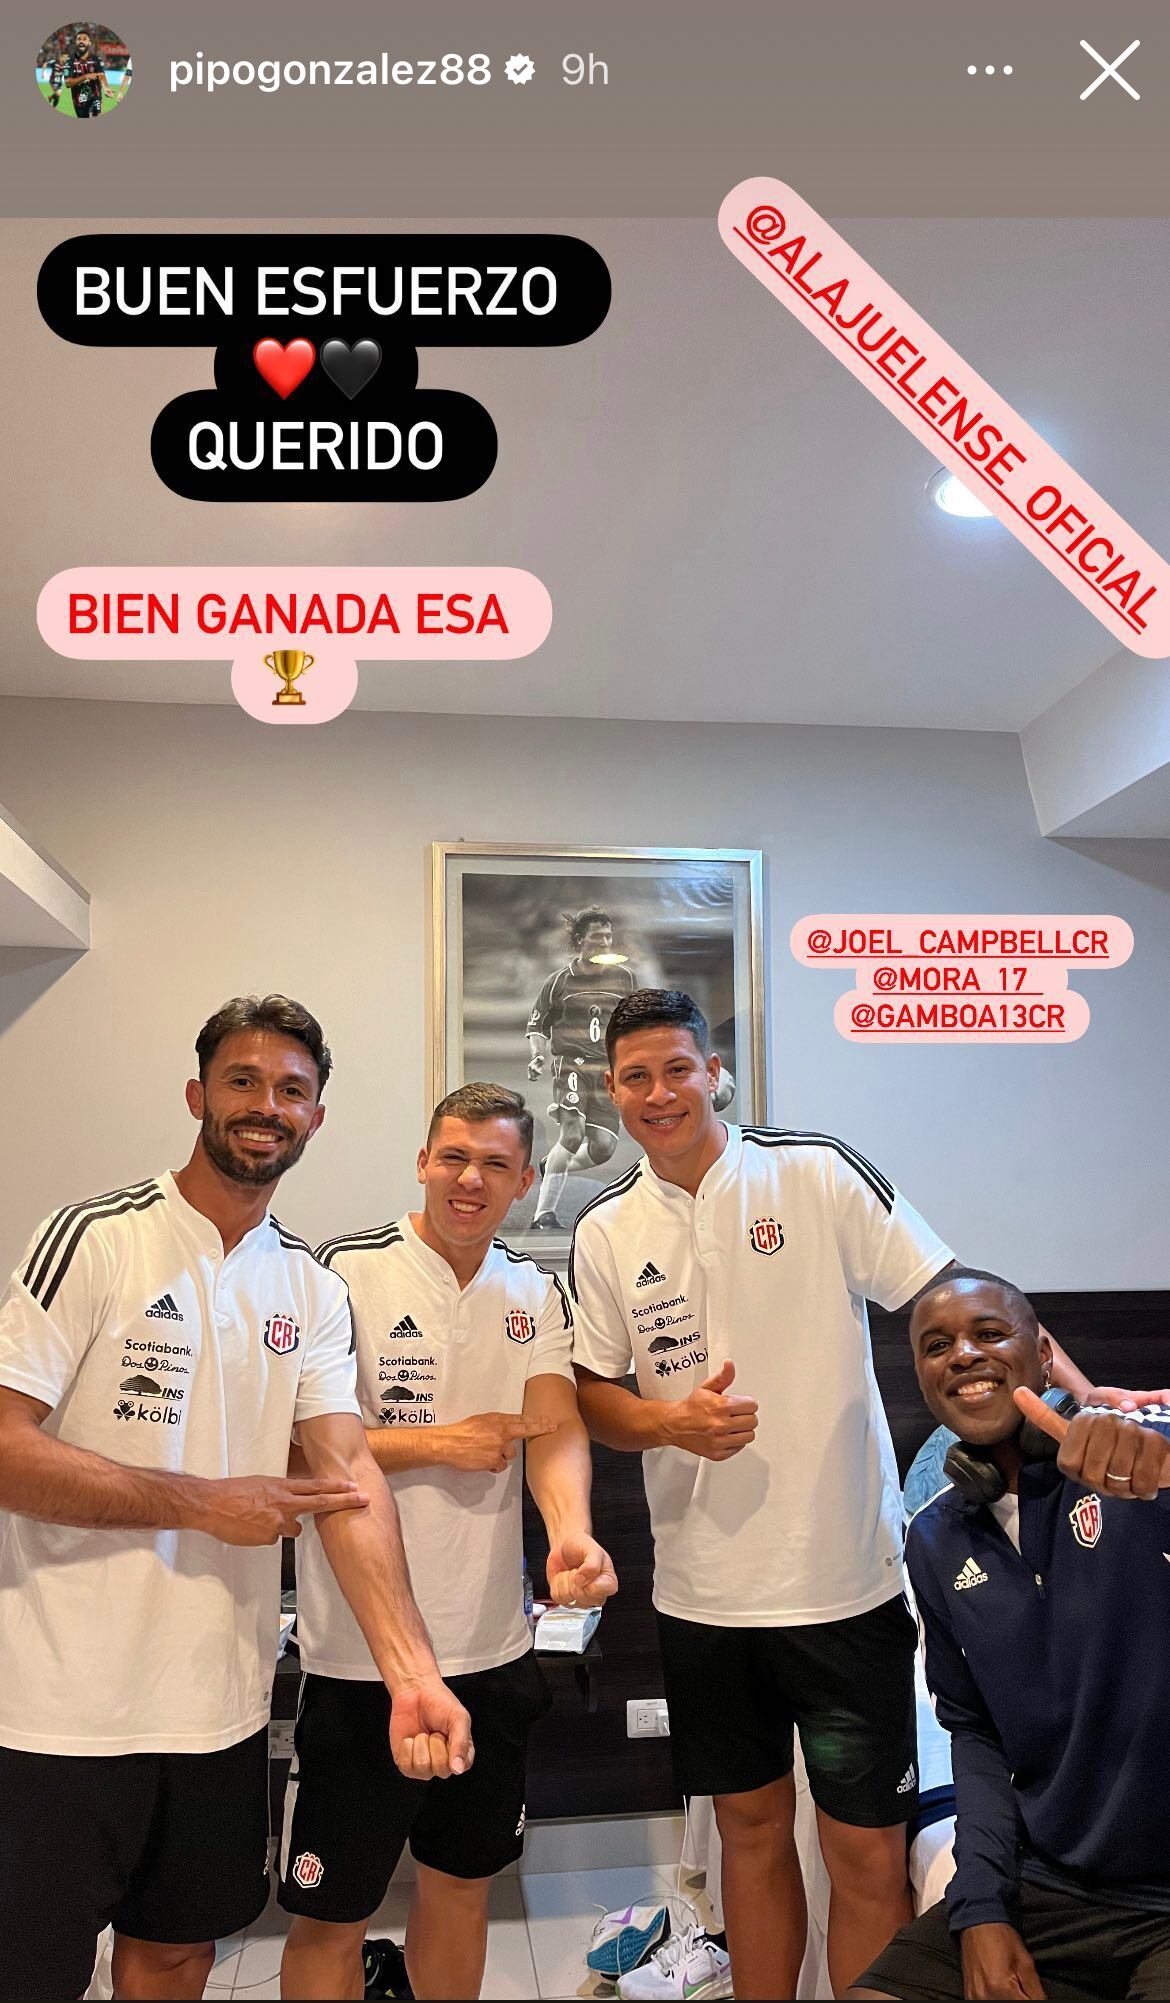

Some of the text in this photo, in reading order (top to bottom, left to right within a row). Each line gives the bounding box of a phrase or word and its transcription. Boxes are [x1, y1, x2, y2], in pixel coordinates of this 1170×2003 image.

[589, 1016, 601, 1043] 6
[755, 1224, 778, 1250] CR
[635, 1273, 667, 1288] adidas
[145, 1308, 184, 1322] adidas
[637, 1312, 695, 1334] Dos Pinos
[271, 1320, 293, 1350] CR
[389, 1328, 424, 1339] adidas
[510, 1315, 530, 1340] CR
[679, 1331, 701, 1346] INS
[120, 1355, 190, 1375] Dos Pinos
[378, 1369, 437, 1382] Dos Pinos
[161, 1387, 185, 1400] INS
[415, 1392, 434, 1402] INS
[136, 1403, 182, 1426] kölbi
[398, 1408, 436, 1424] kölbi
[1080, 1504, 1098, 1538] CR
[953, 1572, 989, 1591] adidas
[300, 1859, 318, 1882] CR
